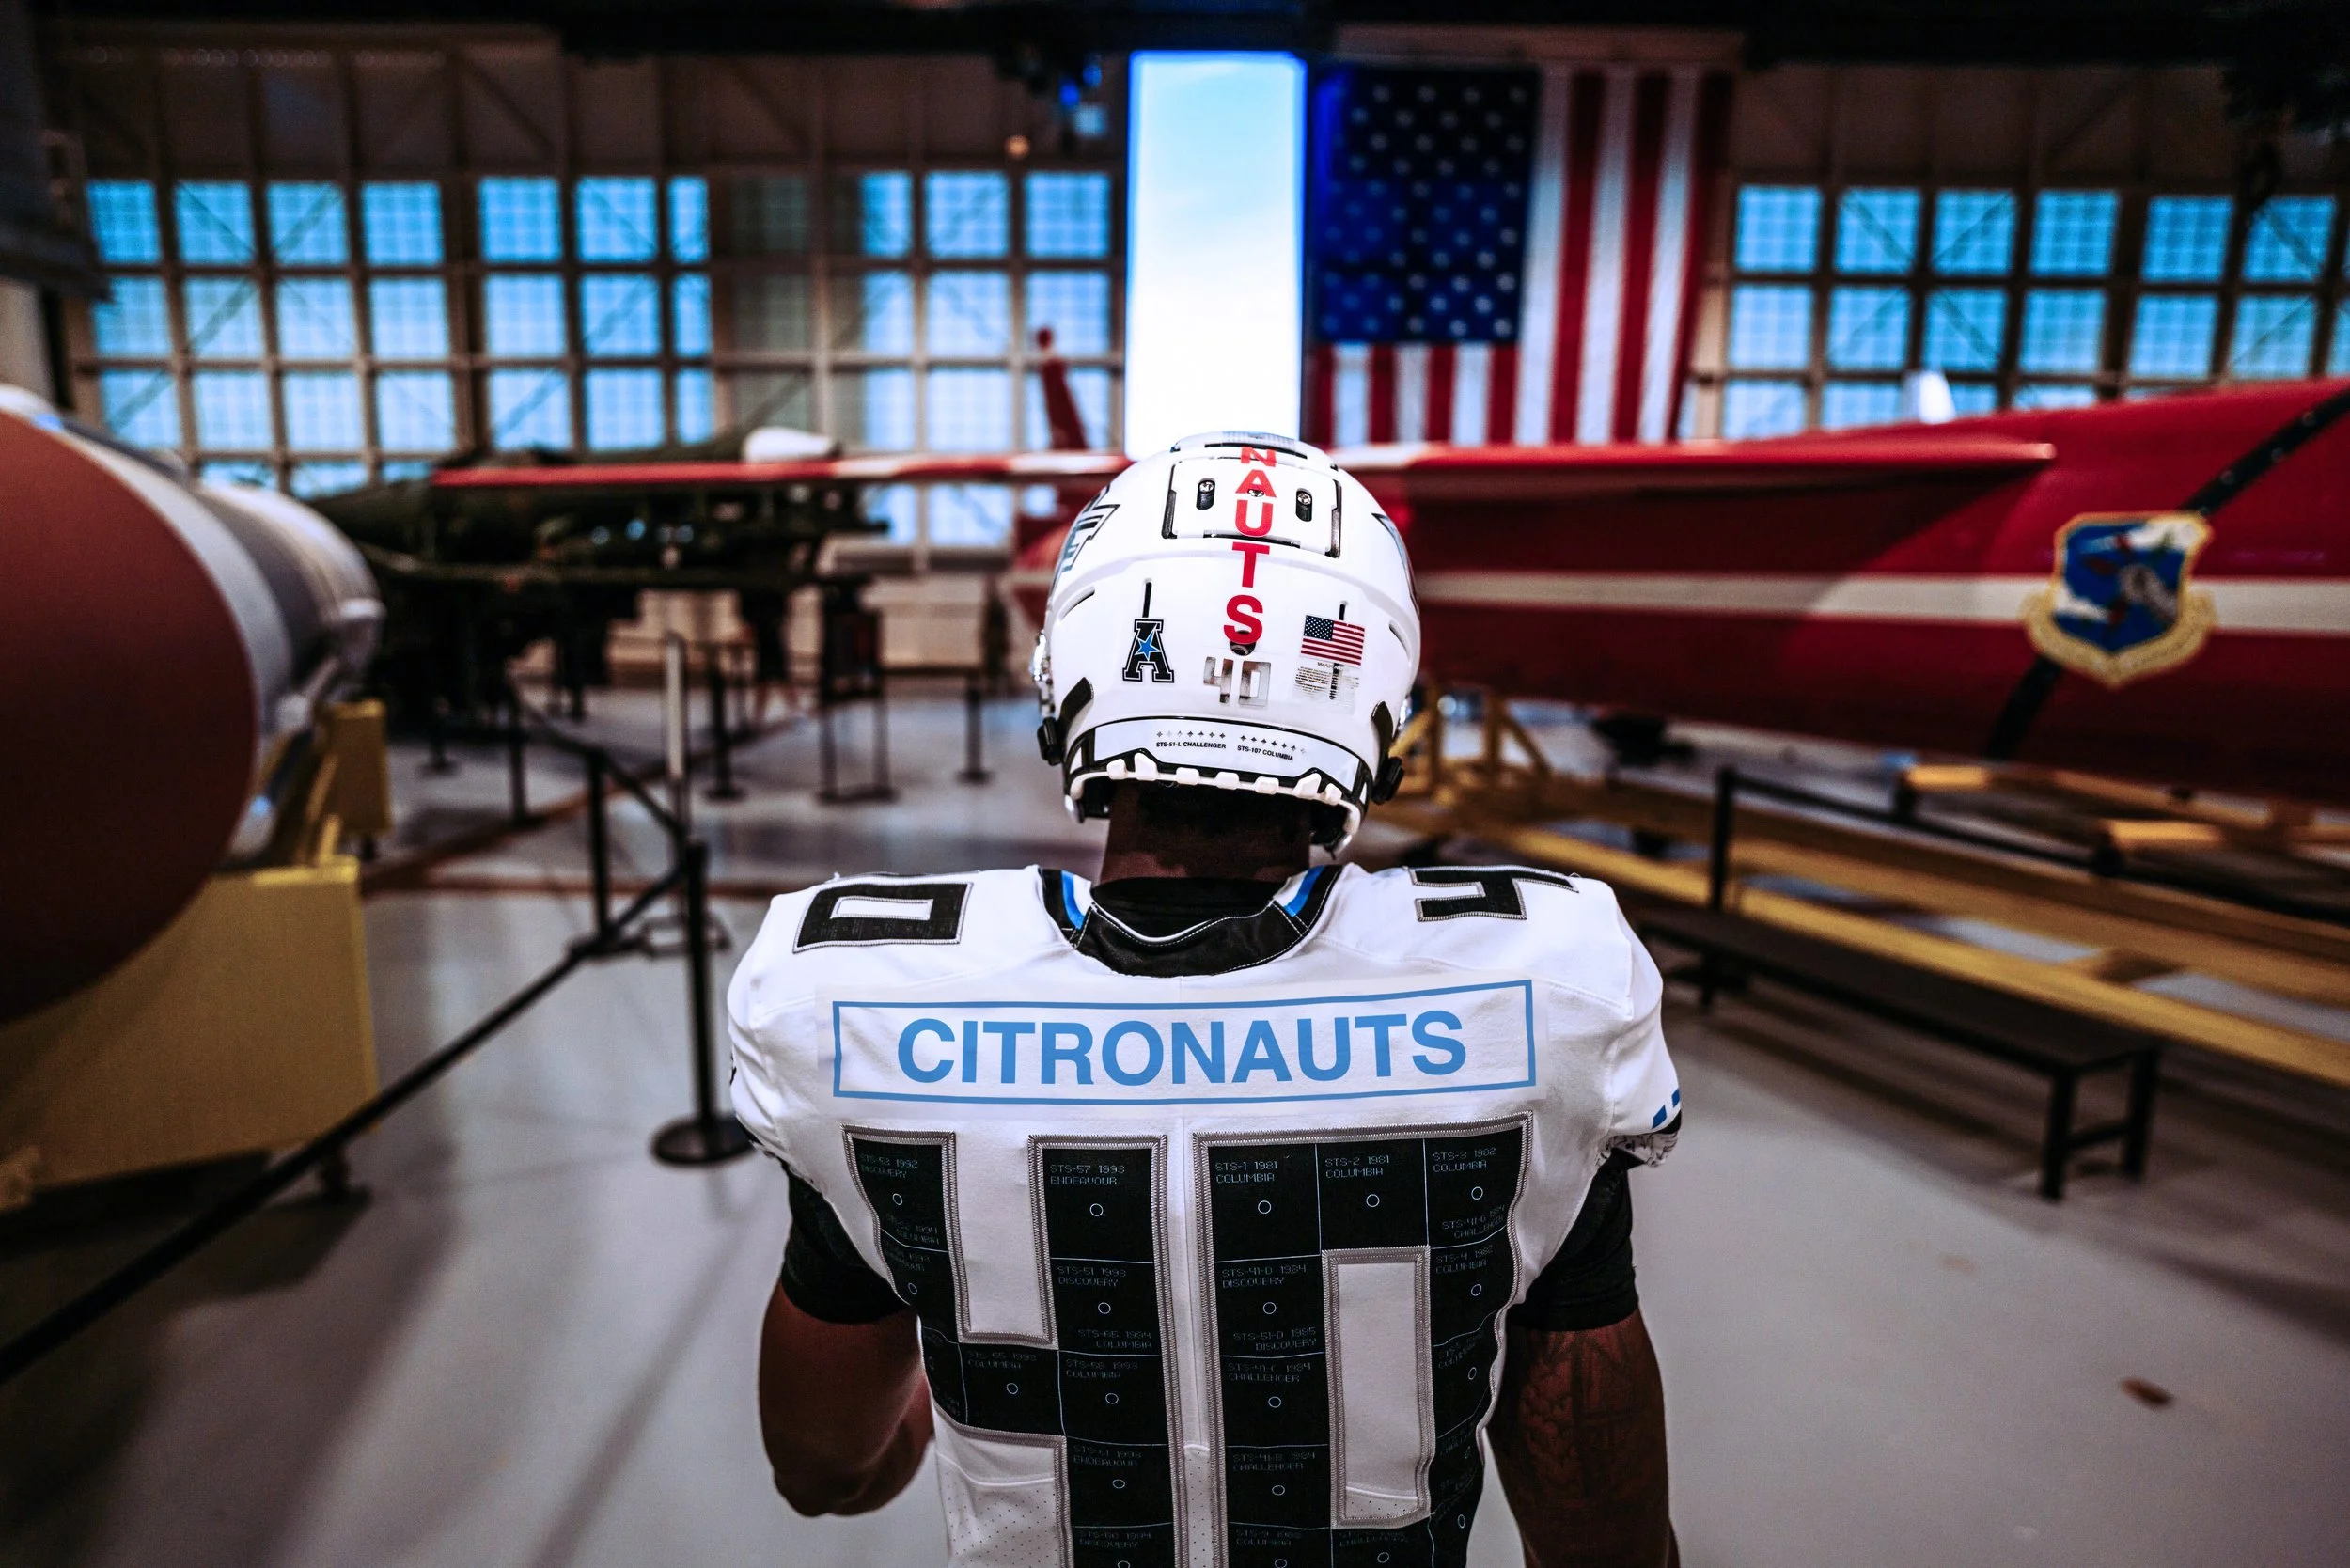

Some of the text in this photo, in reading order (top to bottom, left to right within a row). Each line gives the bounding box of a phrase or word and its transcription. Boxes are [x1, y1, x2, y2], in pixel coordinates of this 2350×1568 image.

[1203, 656, 1271, 708] 40
[1237, 745, 1293, 761] STS-107 COLUMBIA
[898, 1010, 1466, 1087] CITRONAUTS
[1433, 1147, 1496, 1161] STS-3 1982
[1214, 1160, 1277, 1171] STS-1 1981
[1324, 1154, 1389, 1167] STS-2 1981
[1433, 1159, 1487, 1173] COLUMBIA
[1050, 1164, 1125, 1174] STS-57 1993
[1325, 1167, 1383, 1178] COLUMBIA
[1050, 1175, 1117, 1185] ENDEAVOUR
[1215, 1172, 1275, 1184] COLUMBIA
[1057, 1266, 1127, 1277] STS-51 1993
[1222, 1264, 1307, 1278] STS-41-D 1984
[1058, 1276, 1119, 1287] DISCOVERY
[1222, 1277, 1284, 1289] DISCOVERY
[840, 1110, 1534, 1568] 40
[1256, 1338, 1316, 1350] DISCOVERY
